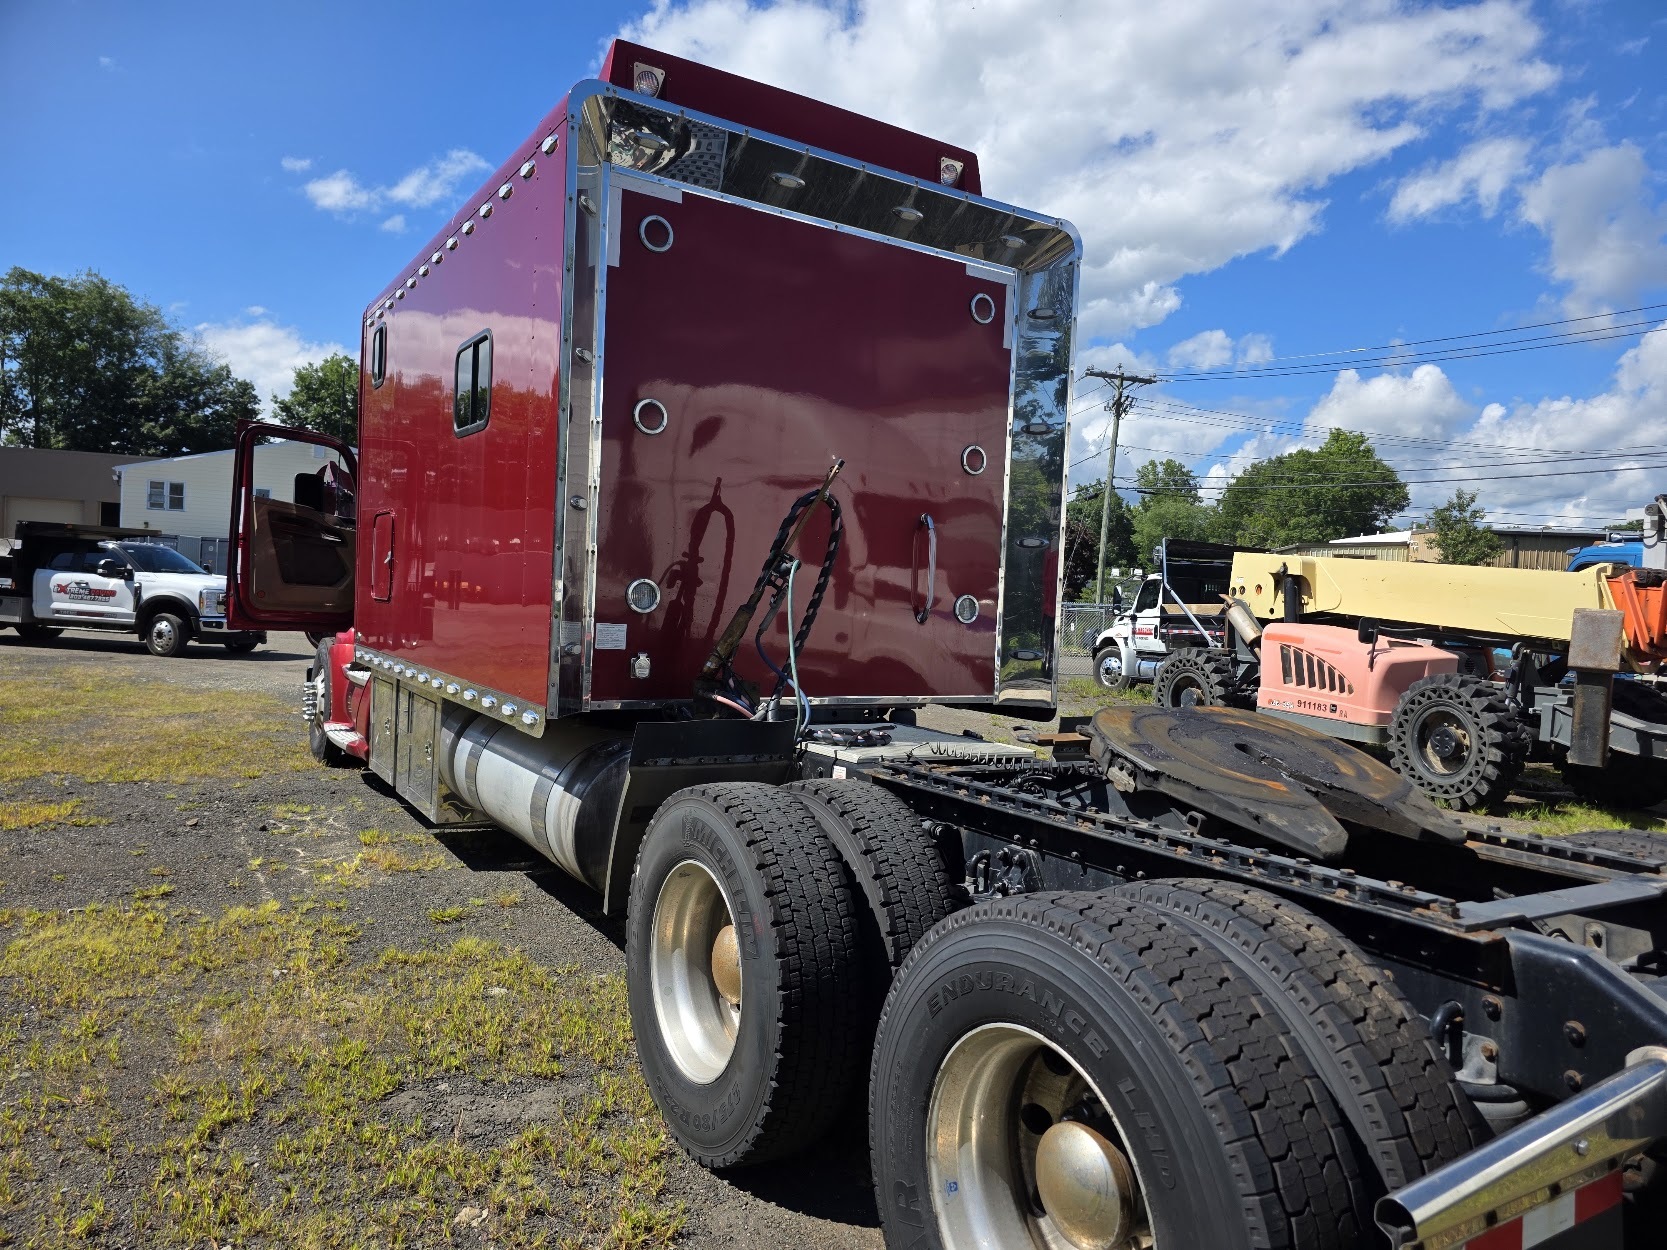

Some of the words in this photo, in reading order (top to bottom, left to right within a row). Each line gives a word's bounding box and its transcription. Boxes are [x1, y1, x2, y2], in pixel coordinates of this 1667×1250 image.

[1297, 699, 1327, 712] 911183
[693, 816, 760, 960] MICHELIN
[926, 970, 1110, 1060] ENDURANCE
